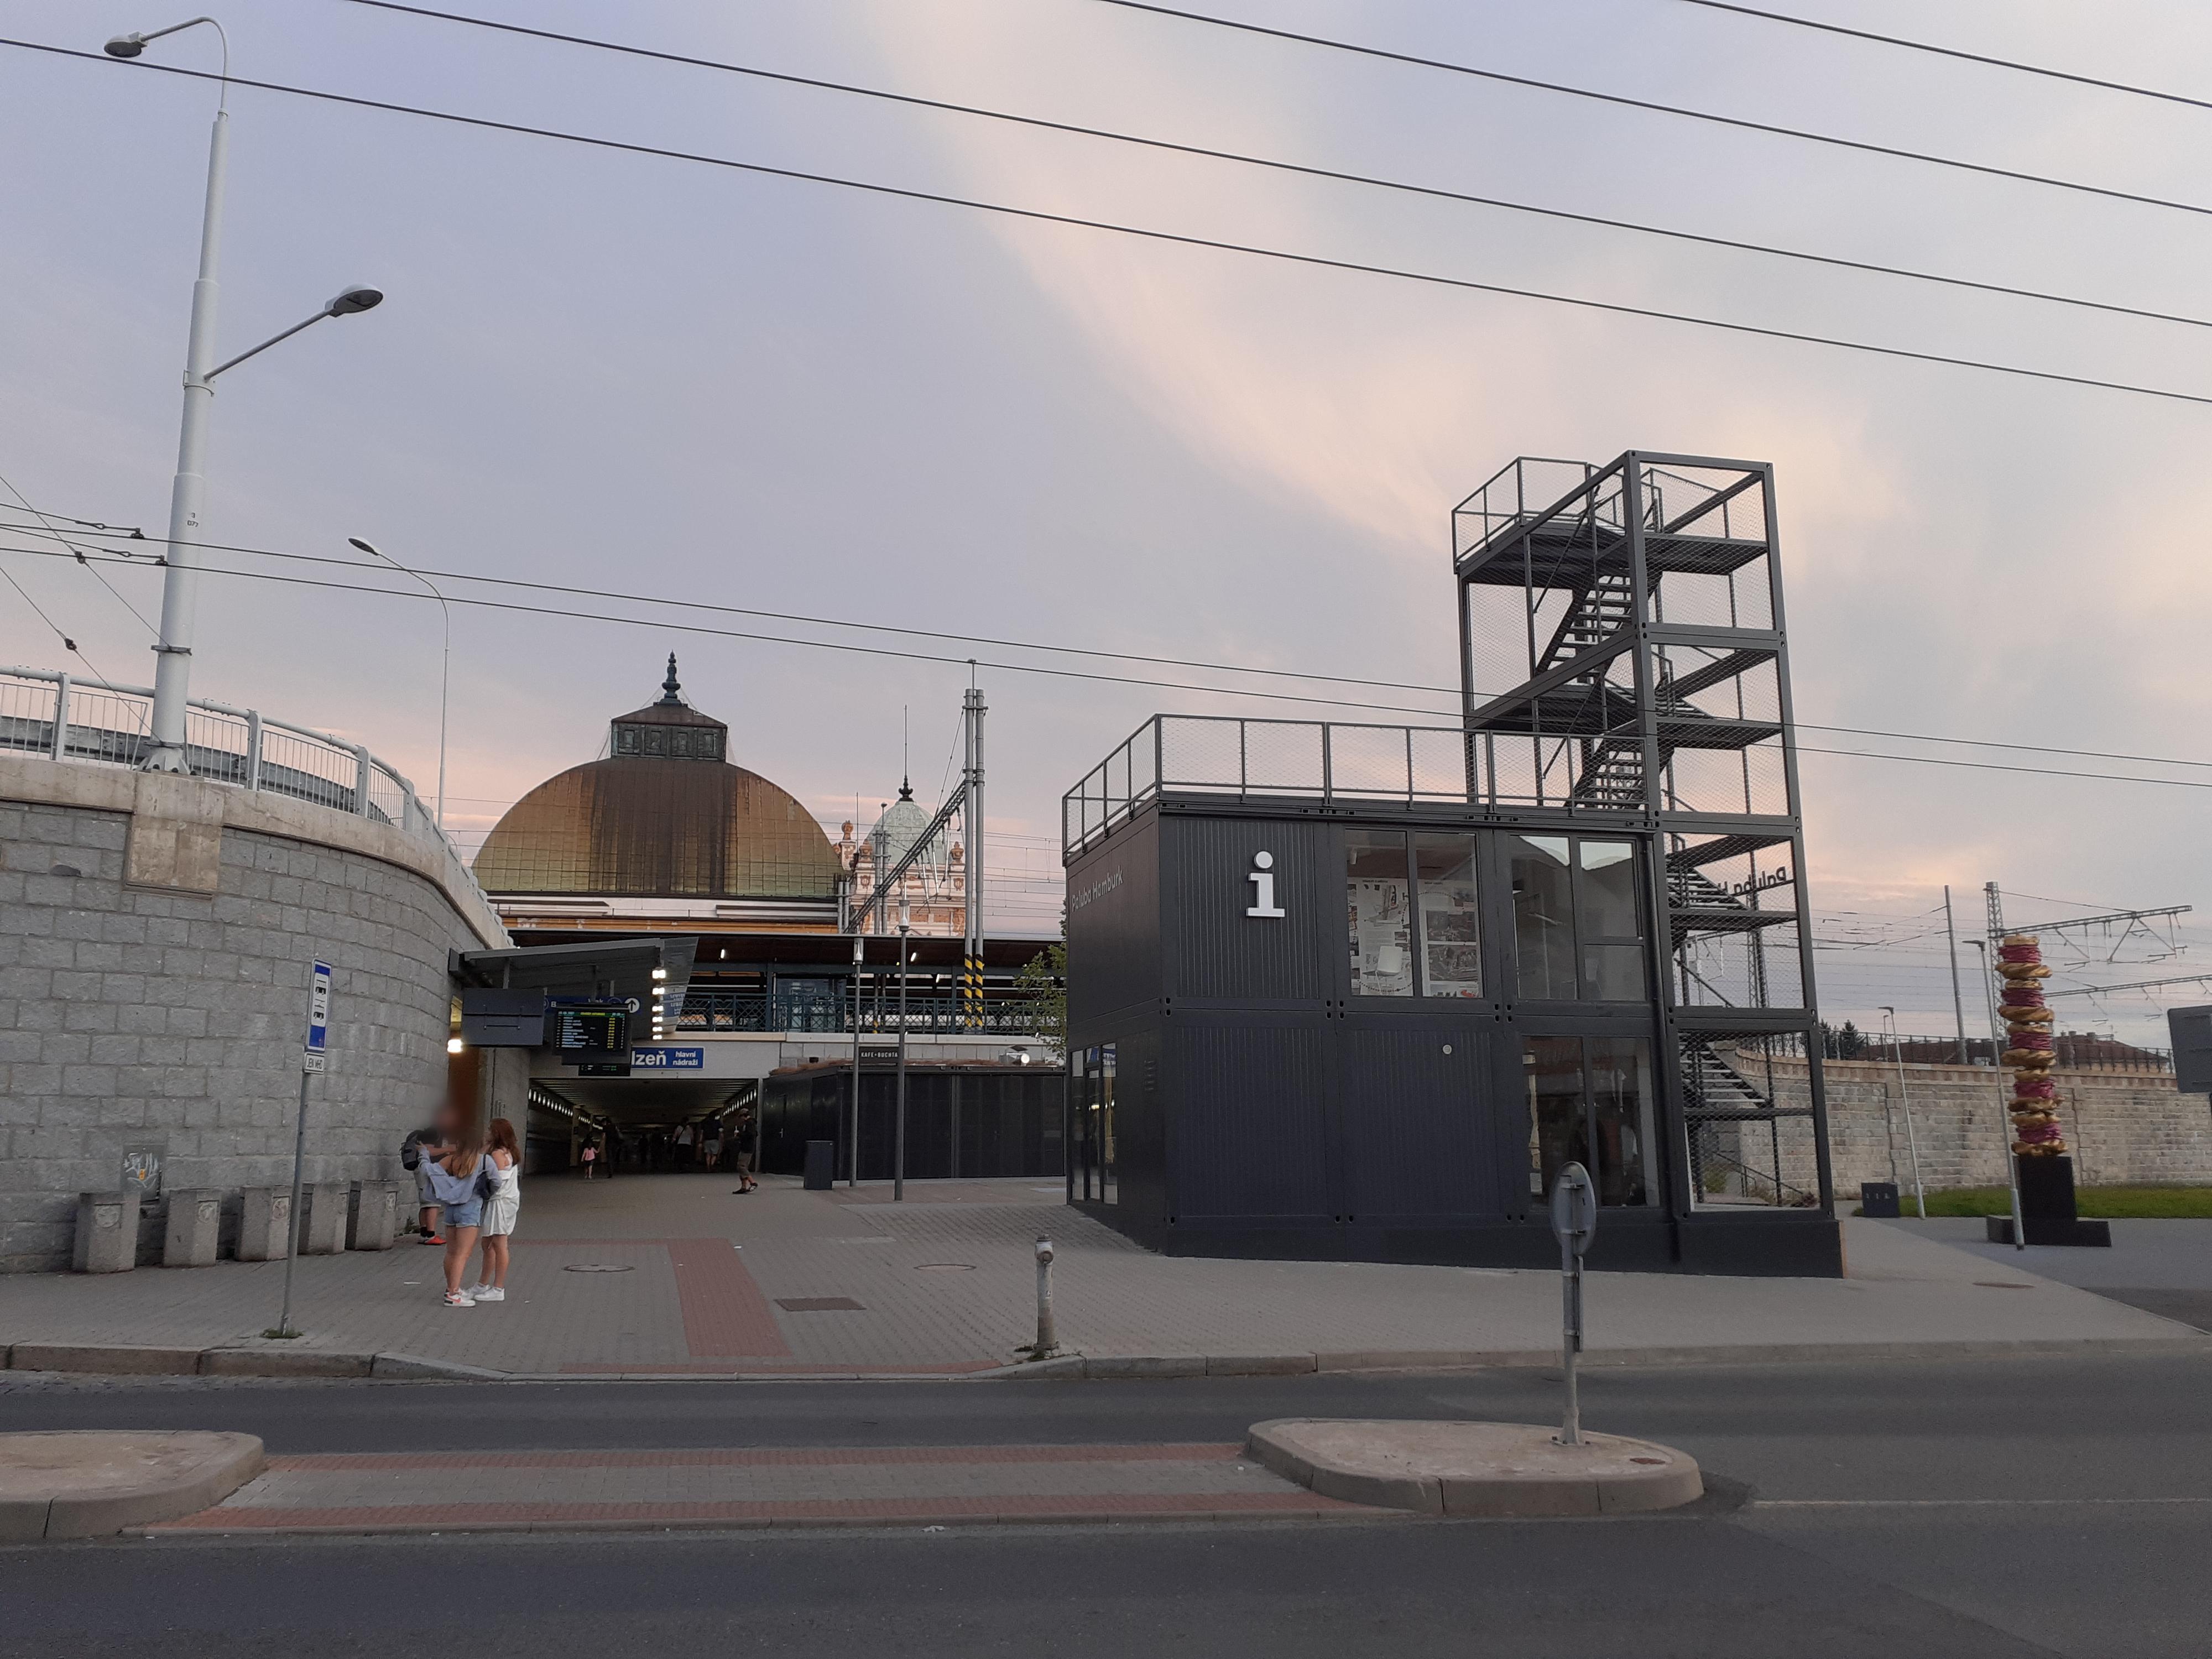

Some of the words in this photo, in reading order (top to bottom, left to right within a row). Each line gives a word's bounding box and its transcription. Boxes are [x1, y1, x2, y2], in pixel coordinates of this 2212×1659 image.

[1072, 886, 1092, 912] Paluba
[1093, 865, 1123, 900] Hamburk
[630, 1050, 667, 1066] lzeň
